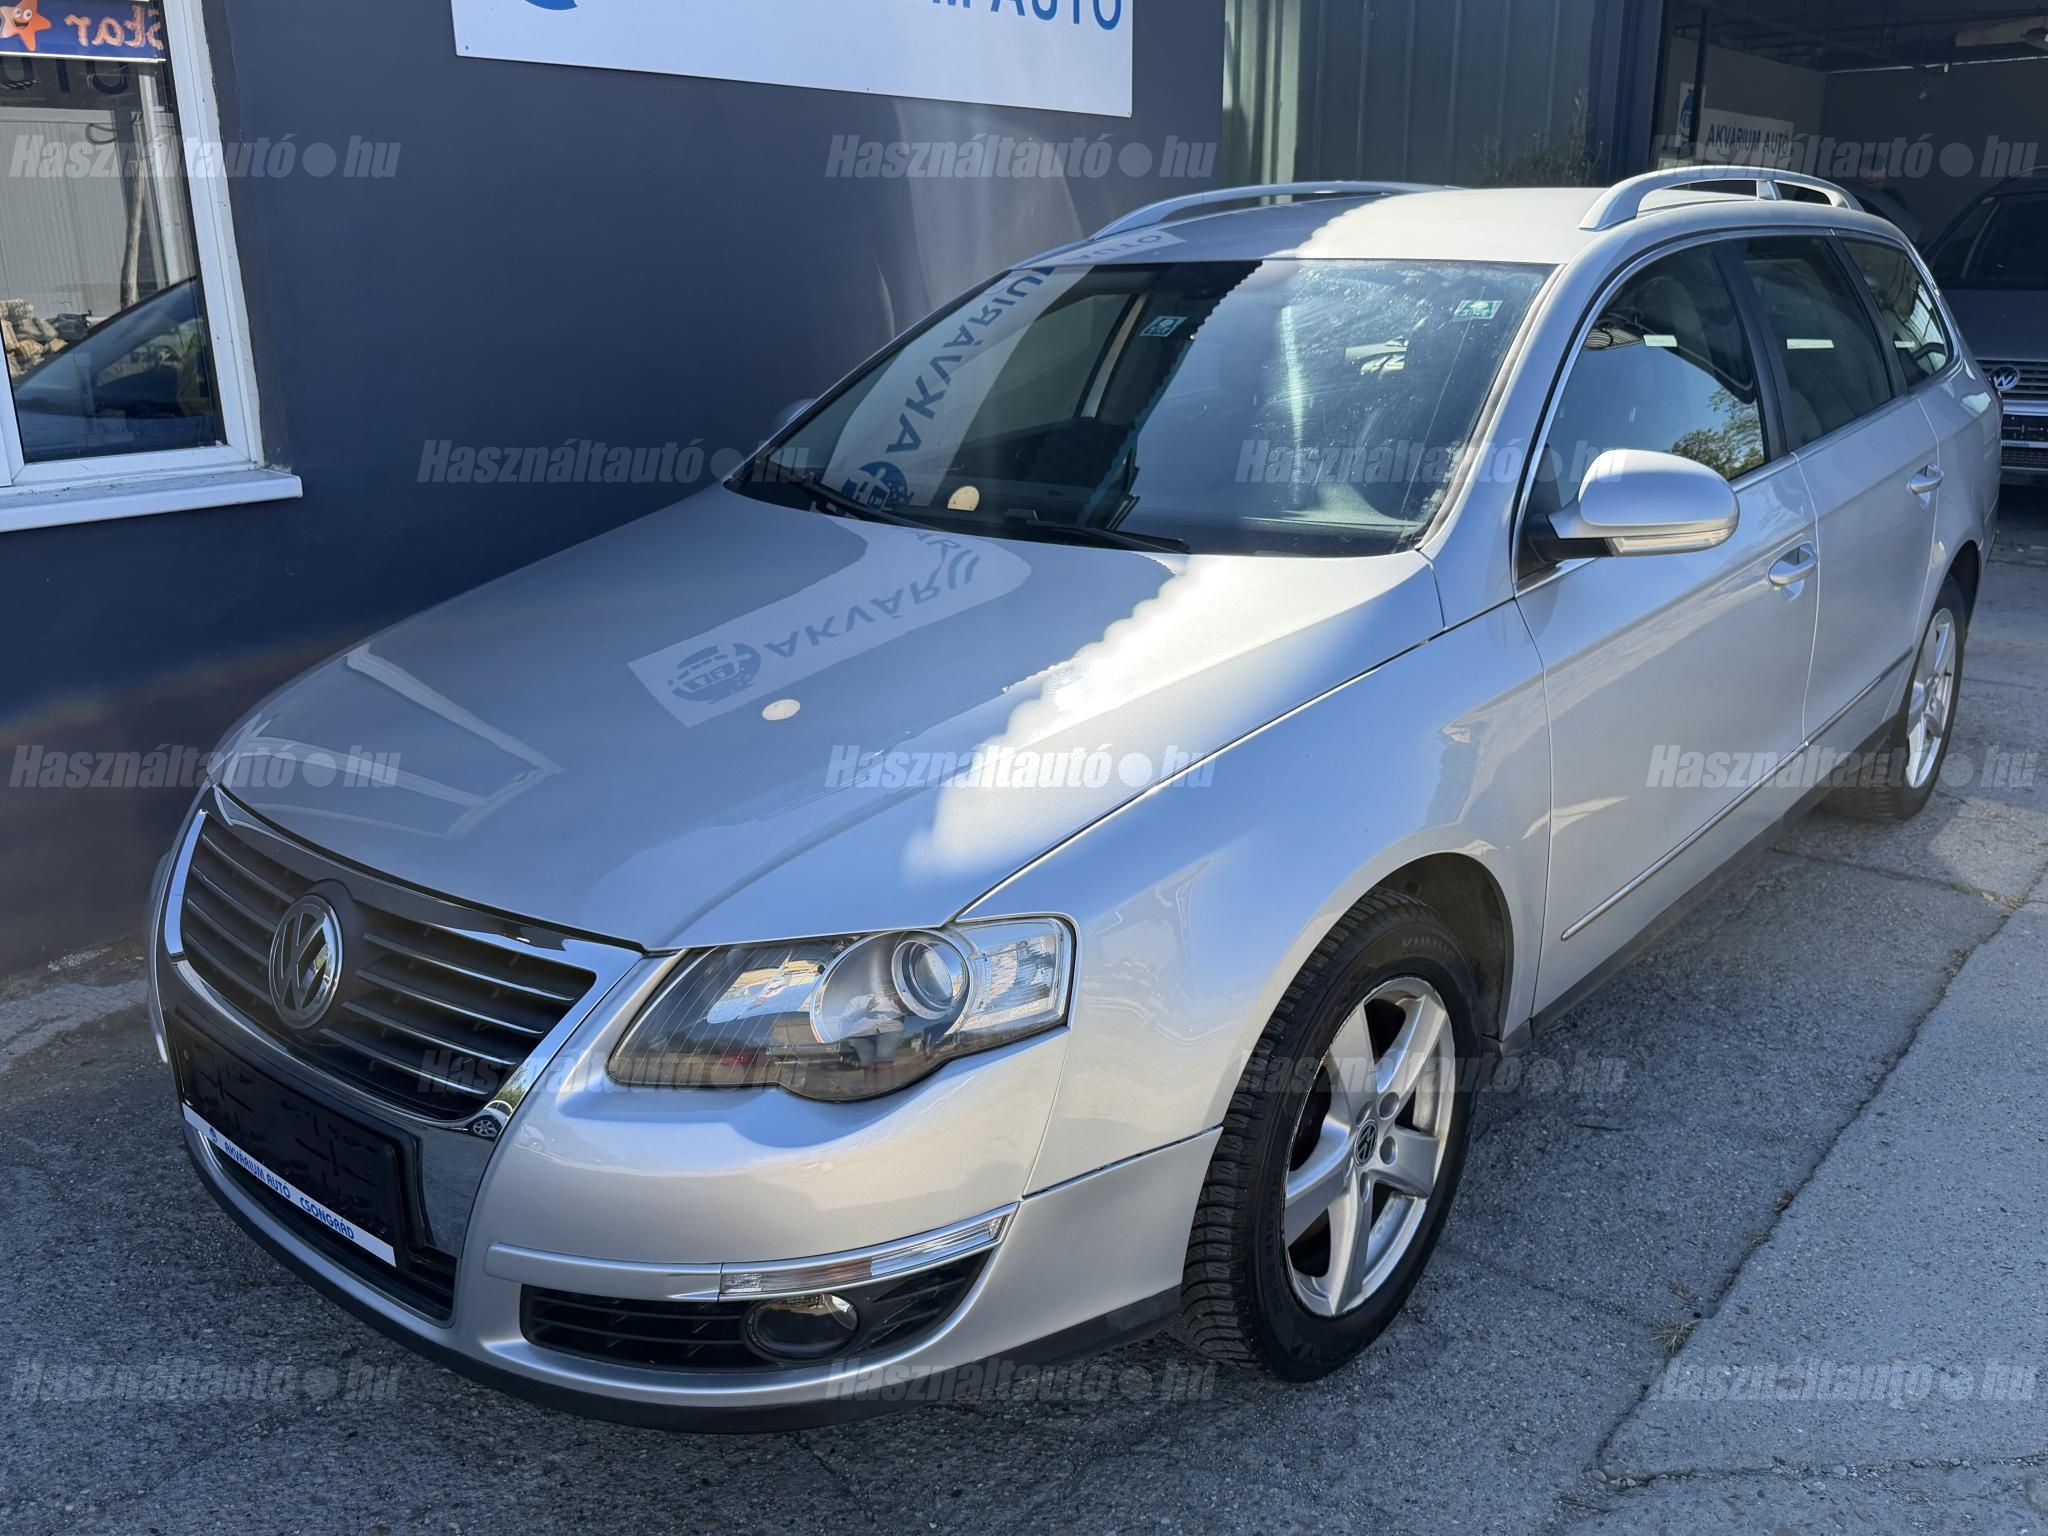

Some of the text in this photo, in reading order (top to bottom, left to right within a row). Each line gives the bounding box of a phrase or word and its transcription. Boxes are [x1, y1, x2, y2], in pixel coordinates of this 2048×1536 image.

[1707, 121, 1789, 155] AKVÁRIUM AUTÓ
[224, 1141, 355, 1240] AKVÁRIUM AUTÓ CSONGRÁD
